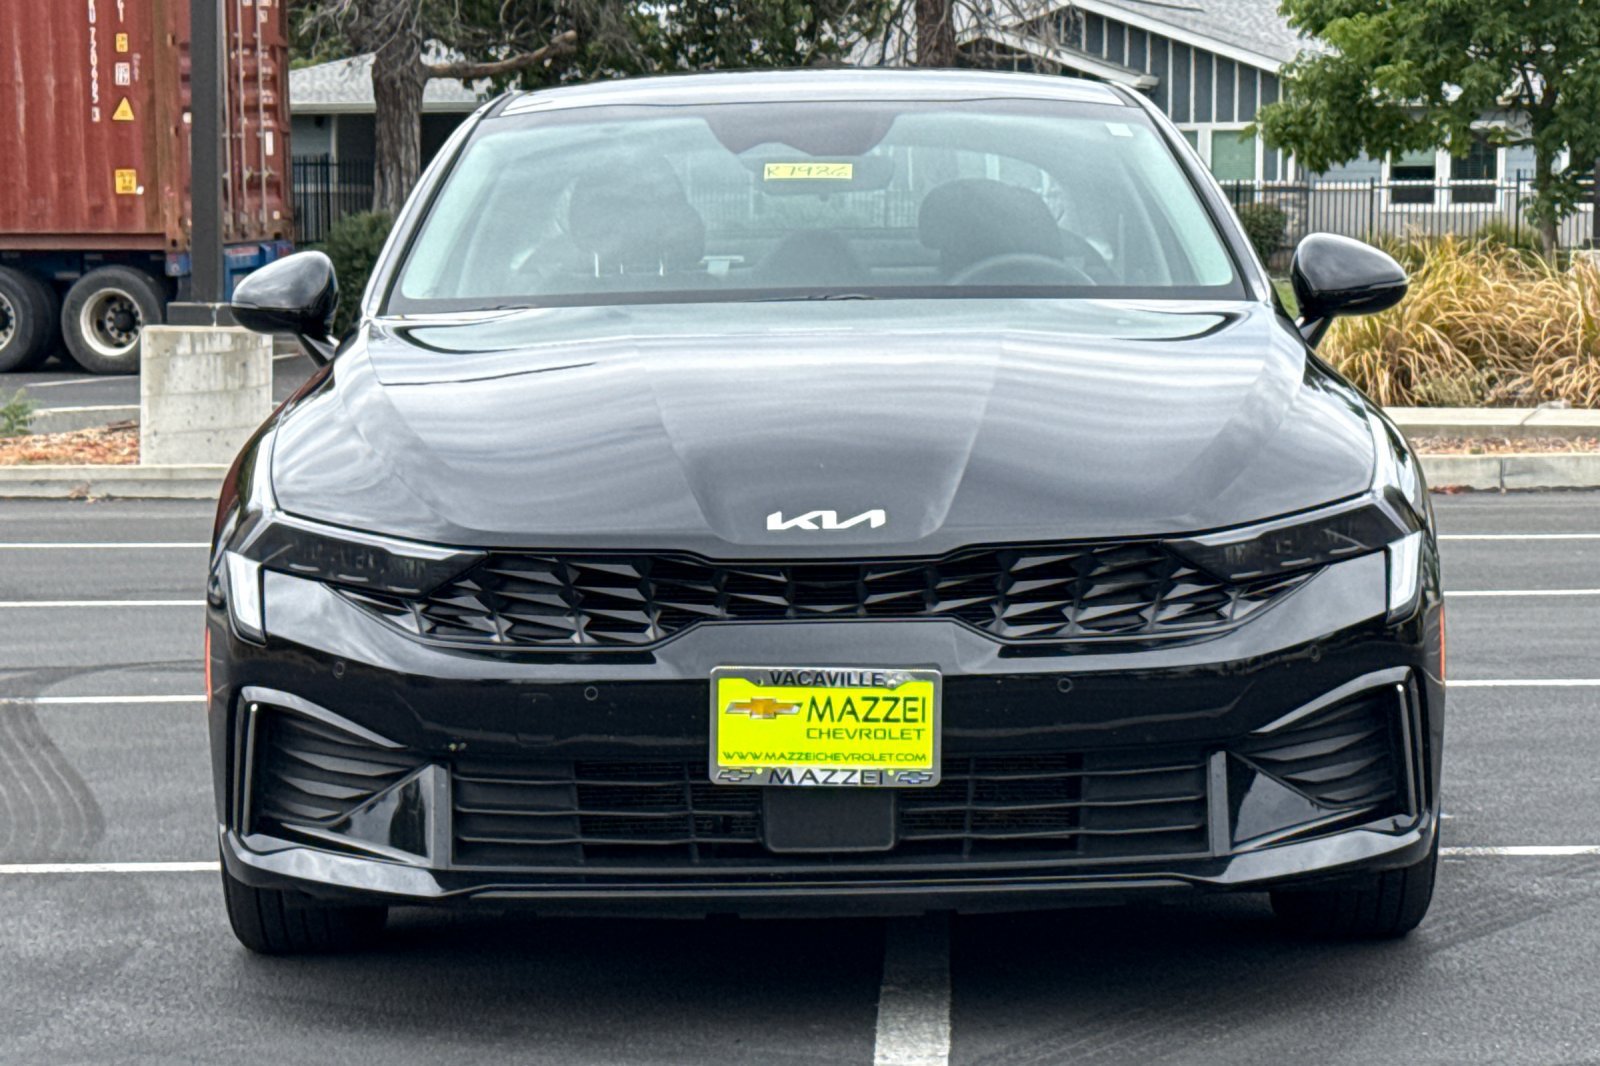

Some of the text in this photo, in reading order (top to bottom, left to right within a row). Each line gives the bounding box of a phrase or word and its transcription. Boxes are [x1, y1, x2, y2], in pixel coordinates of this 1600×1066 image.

[766, 508, 887, 530] KIA
[769, 670, 885, 687] VACAVILLE
[806, 696, 926, 723] MAZZEI
[806, 727, 926, 740] CHEVROLET
[722, 751, 926, 762] WWW.MAZZEICHEVROLET.COM
[768, 768, 884, 786] MAZZEI
